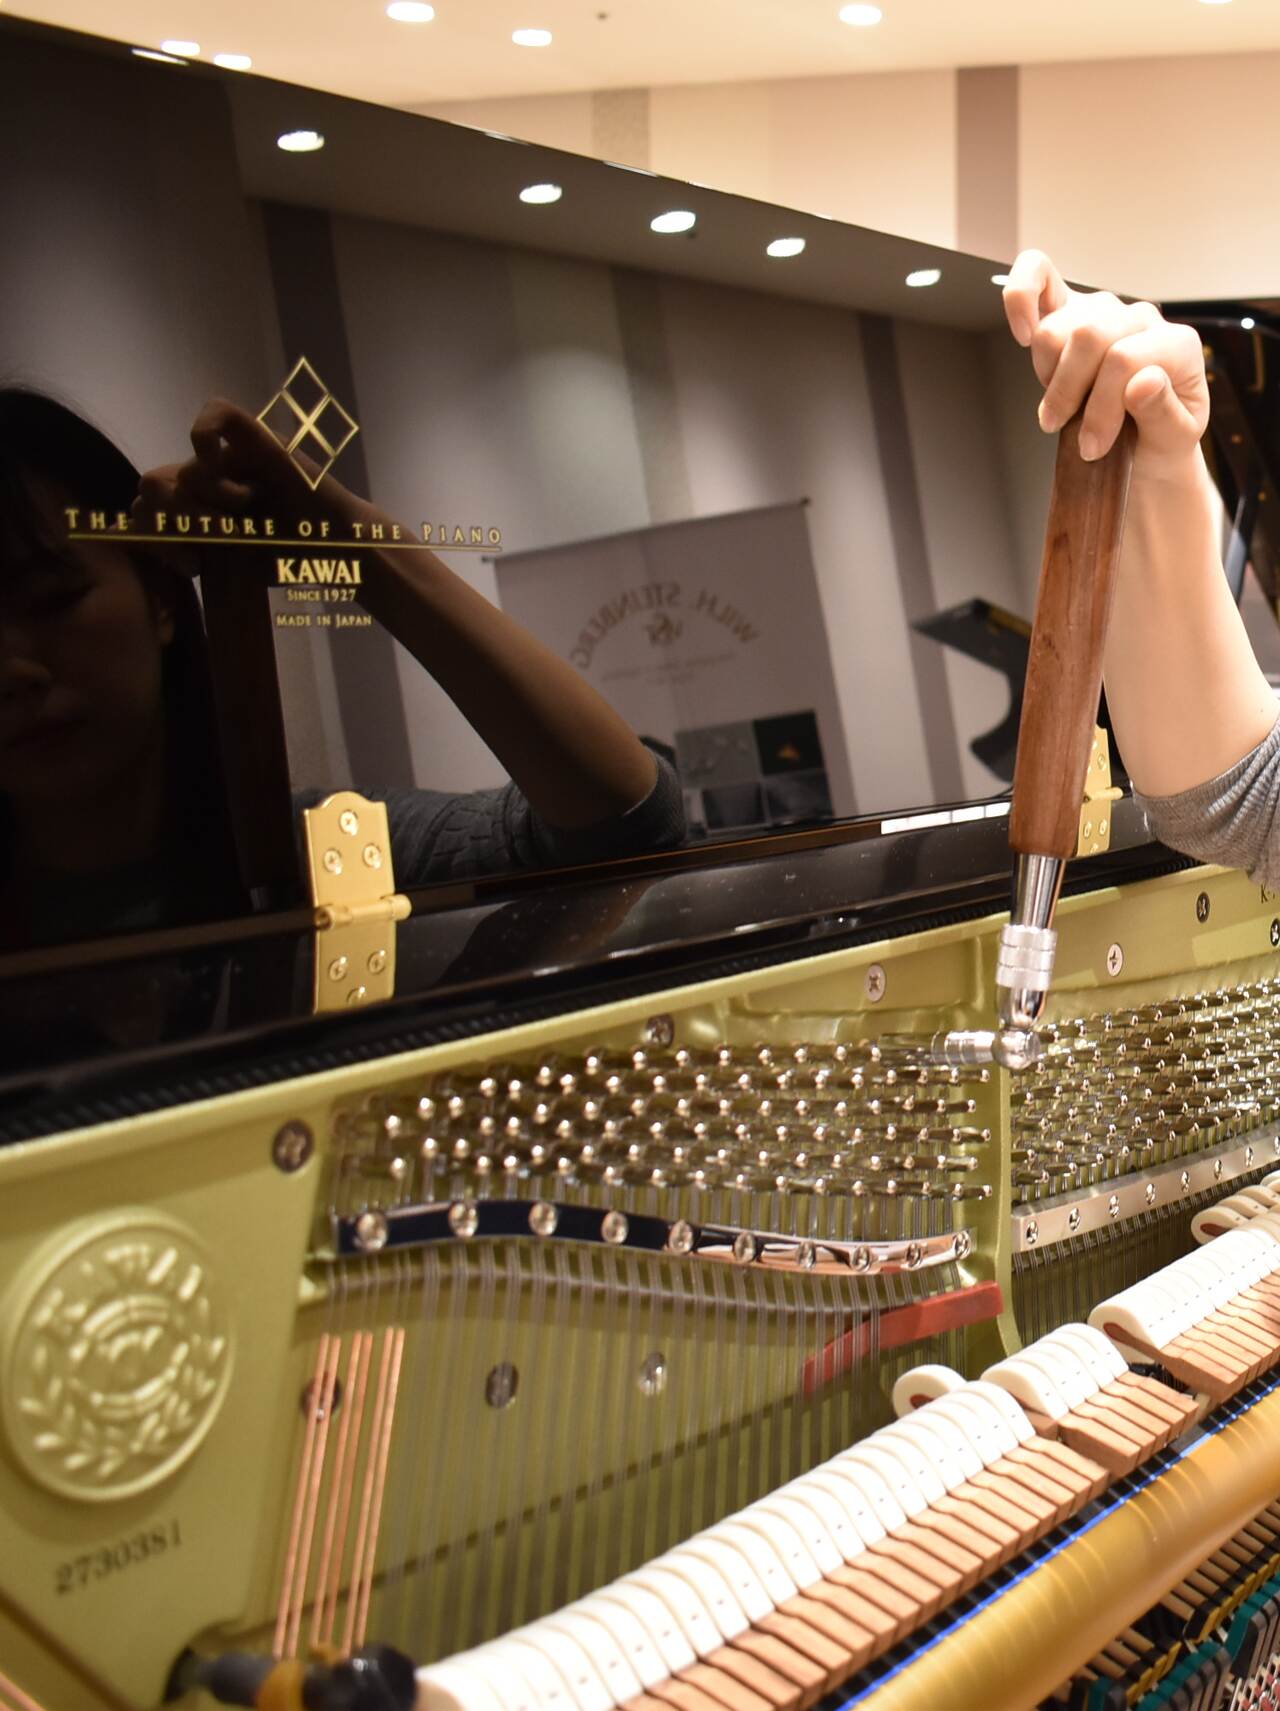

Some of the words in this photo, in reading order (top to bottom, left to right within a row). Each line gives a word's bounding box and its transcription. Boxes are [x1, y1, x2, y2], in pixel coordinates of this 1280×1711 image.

[65, 508, 128, 530] THE
[156, 512, 275, 535] FUTURE
[298, 521, 330, 537] OF
[352, 522, 401, 540] THE
[421, 521, 501, 544] PIANO
[277, 558, 361, 584] KAWAI
[287, 588, 320, 601] SINCE
[323, 589, 356, 602] 1927
[276, 615, 311, 626] MADE
[317, 615, 331, 625] IN
[336, 613, 372, 628] JAPAN
